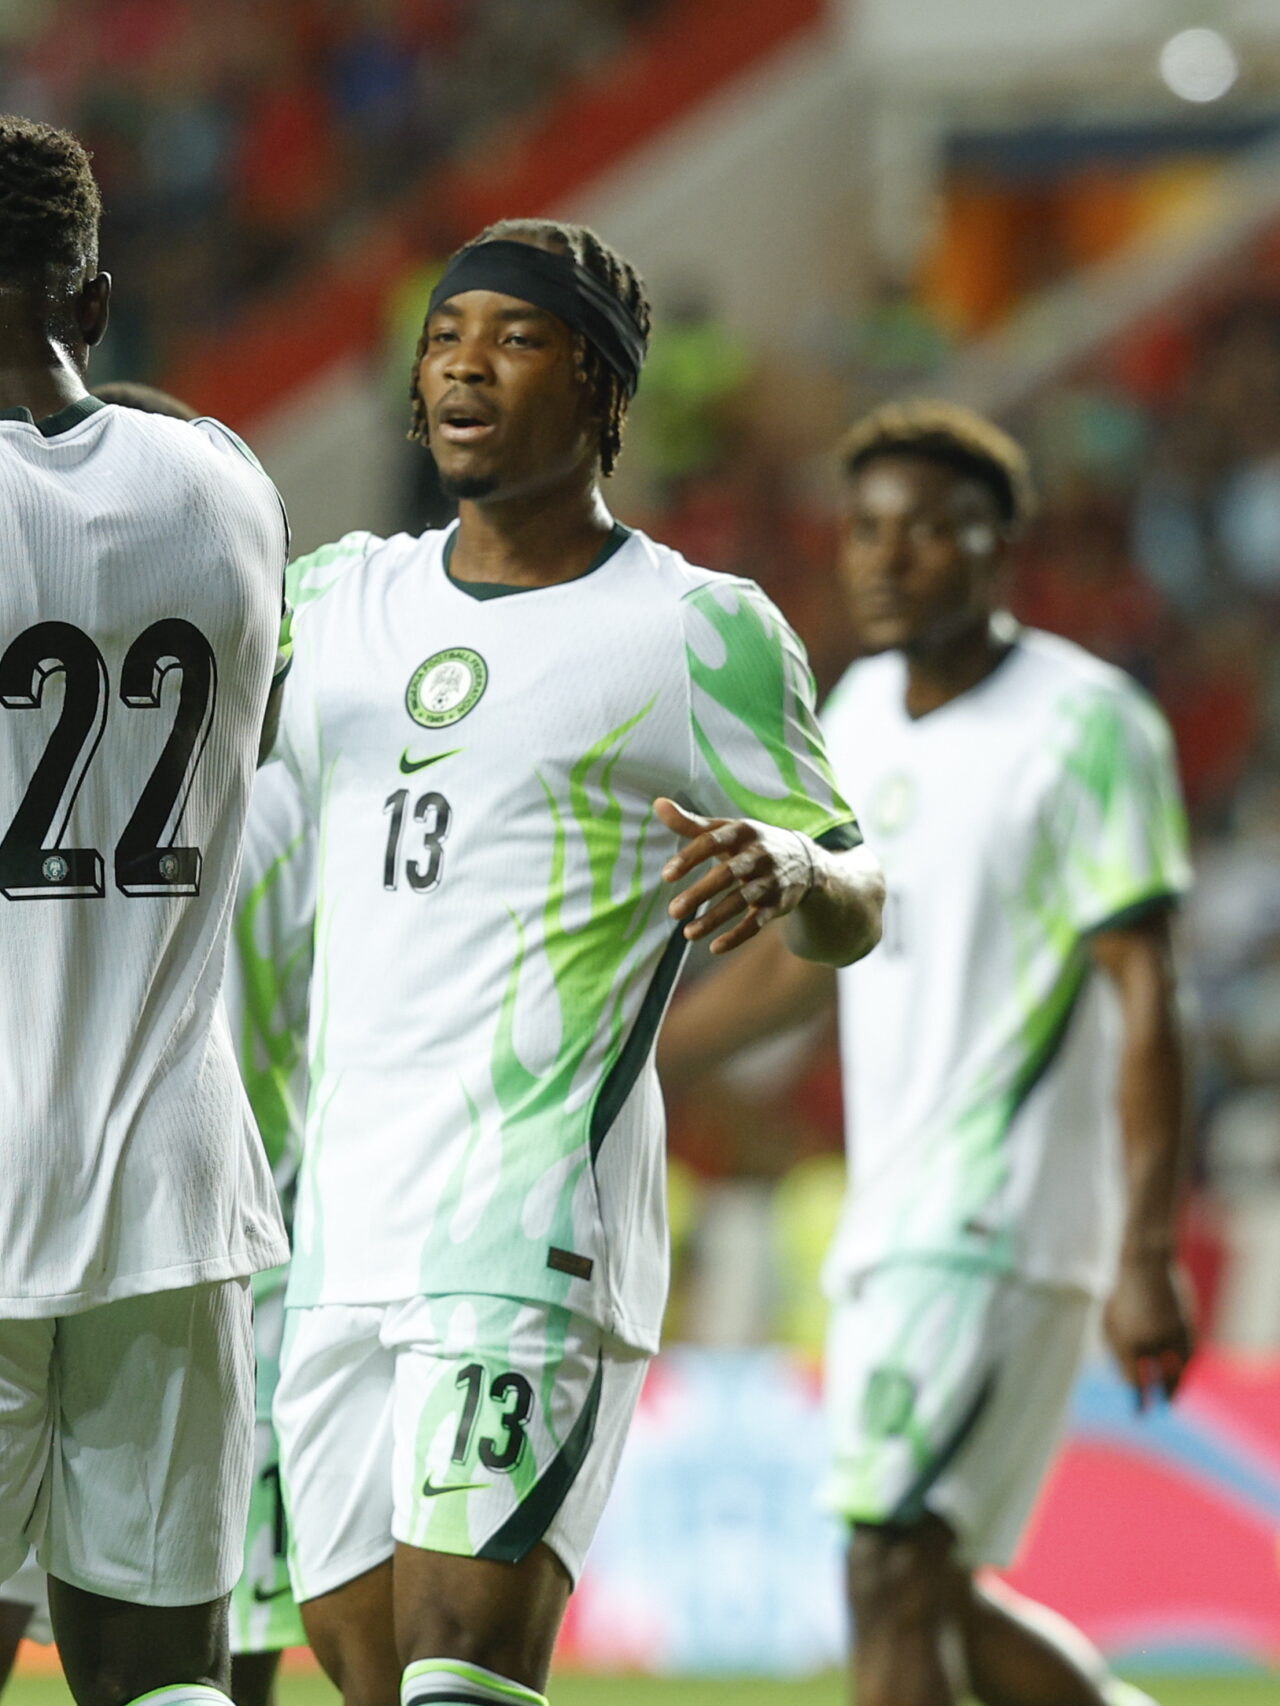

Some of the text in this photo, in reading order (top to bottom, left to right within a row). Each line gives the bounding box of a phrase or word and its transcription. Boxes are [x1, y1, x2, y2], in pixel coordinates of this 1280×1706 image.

[421, 651, 471, 674] FOOTBALL
[457, 657, 485, 715] FEDERATION
[381, 788, 453, 895] 13
[450, 1362, 536, 1474] 13
